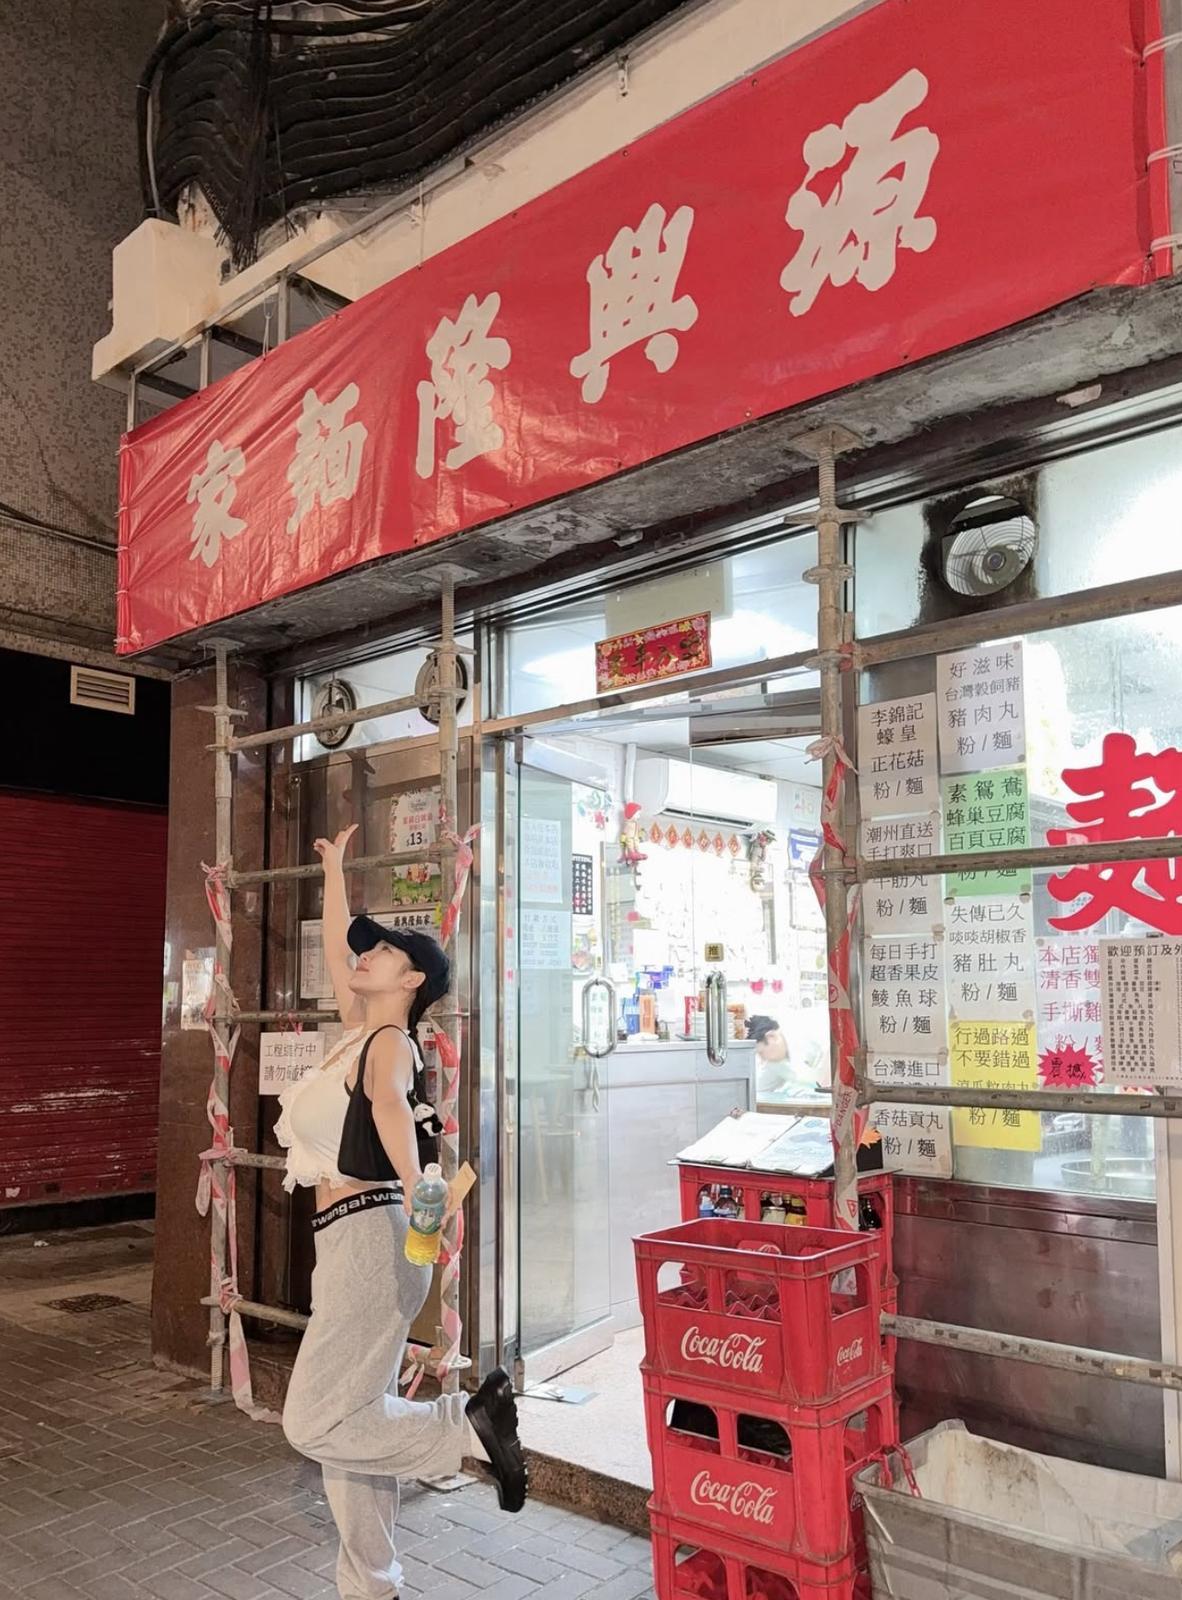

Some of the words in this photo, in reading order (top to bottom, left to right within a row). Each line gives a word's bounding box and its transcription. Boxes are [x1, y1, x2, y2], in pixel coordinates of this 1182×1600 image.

[950, 653, 1014, 678] 好滋味
[871, 702, 924, 728] 李錦記
[948, 702, 1019, 729] 豬肉丸
[877, 724, 917, 746] 蠔皇
[871, 749, 924, 773] 正花菇
[948, 776, 1022, 803] 素鴛鴦
[946, 803, 1025, 827] 蜂巢豆腐
[866, 820, 933, 843] 潮州直送
[947, 827, 1026, 850] 百頁豆腐
[951, 903, 1024, 924] 失傳已久
[871, 942, 937, 961] 每日手打
[953, 952, 1024, 973] 豬肚丸
[870, 963, 938, 981] 超香果皮
[871, 989, 938, 1008] 鯪魚球
[955, 1027, 1029, 1046] 行過路過
[264, 1043, 316, 1057] 工程進行中
[957, 1050, 1030, 1068] 不要錯過
[873, 1059, 940, 1077] 台灣進口
[875, 1109, 943, 1130] 香菇貢丸
[681, 1326, 766, 1373] Coca-Cola
[837, 1338, 863, 1366] Coca-Cola
[690, 1470, 778, 1525] Coca-Cola
